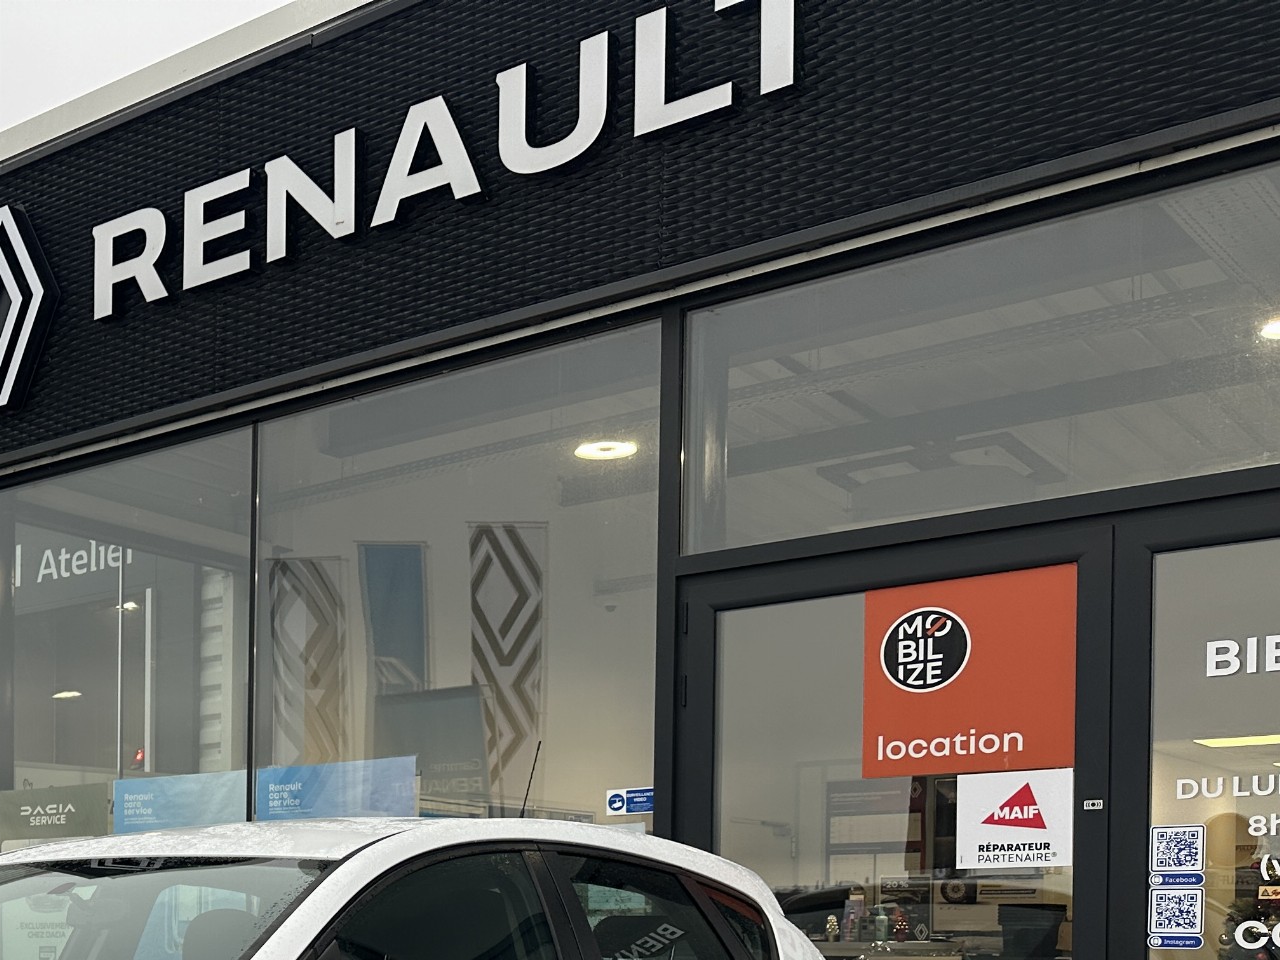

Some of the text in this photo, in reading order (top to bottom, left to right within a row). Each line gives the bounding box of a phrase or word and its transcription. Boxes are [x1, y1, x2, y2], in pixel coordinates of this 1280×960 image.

[92, 0, 794, 321] RENAULT
[898, 638, 944, 664] BIL
[898, 660, 943, 686] IZE
[877, 728, 1025, 761] location
[269, 781, 303, 792] Renault
[1176, 774, 1280, 800] DU LU
[124, 792, 155, 802] Renault
[269, 791, 289, 800] care
[269, 798, 301, 807] service
[20, 804, 75, 816] DACIA
[993, 805, 1040, 821] MAIF
[29, 814, 67, 826] SERVICE
[978, 841, 1051, 853] RÉPARATEUR
[1165, 876, 1197, 884] Facebook
[1234, 920, 1280, 950] C
